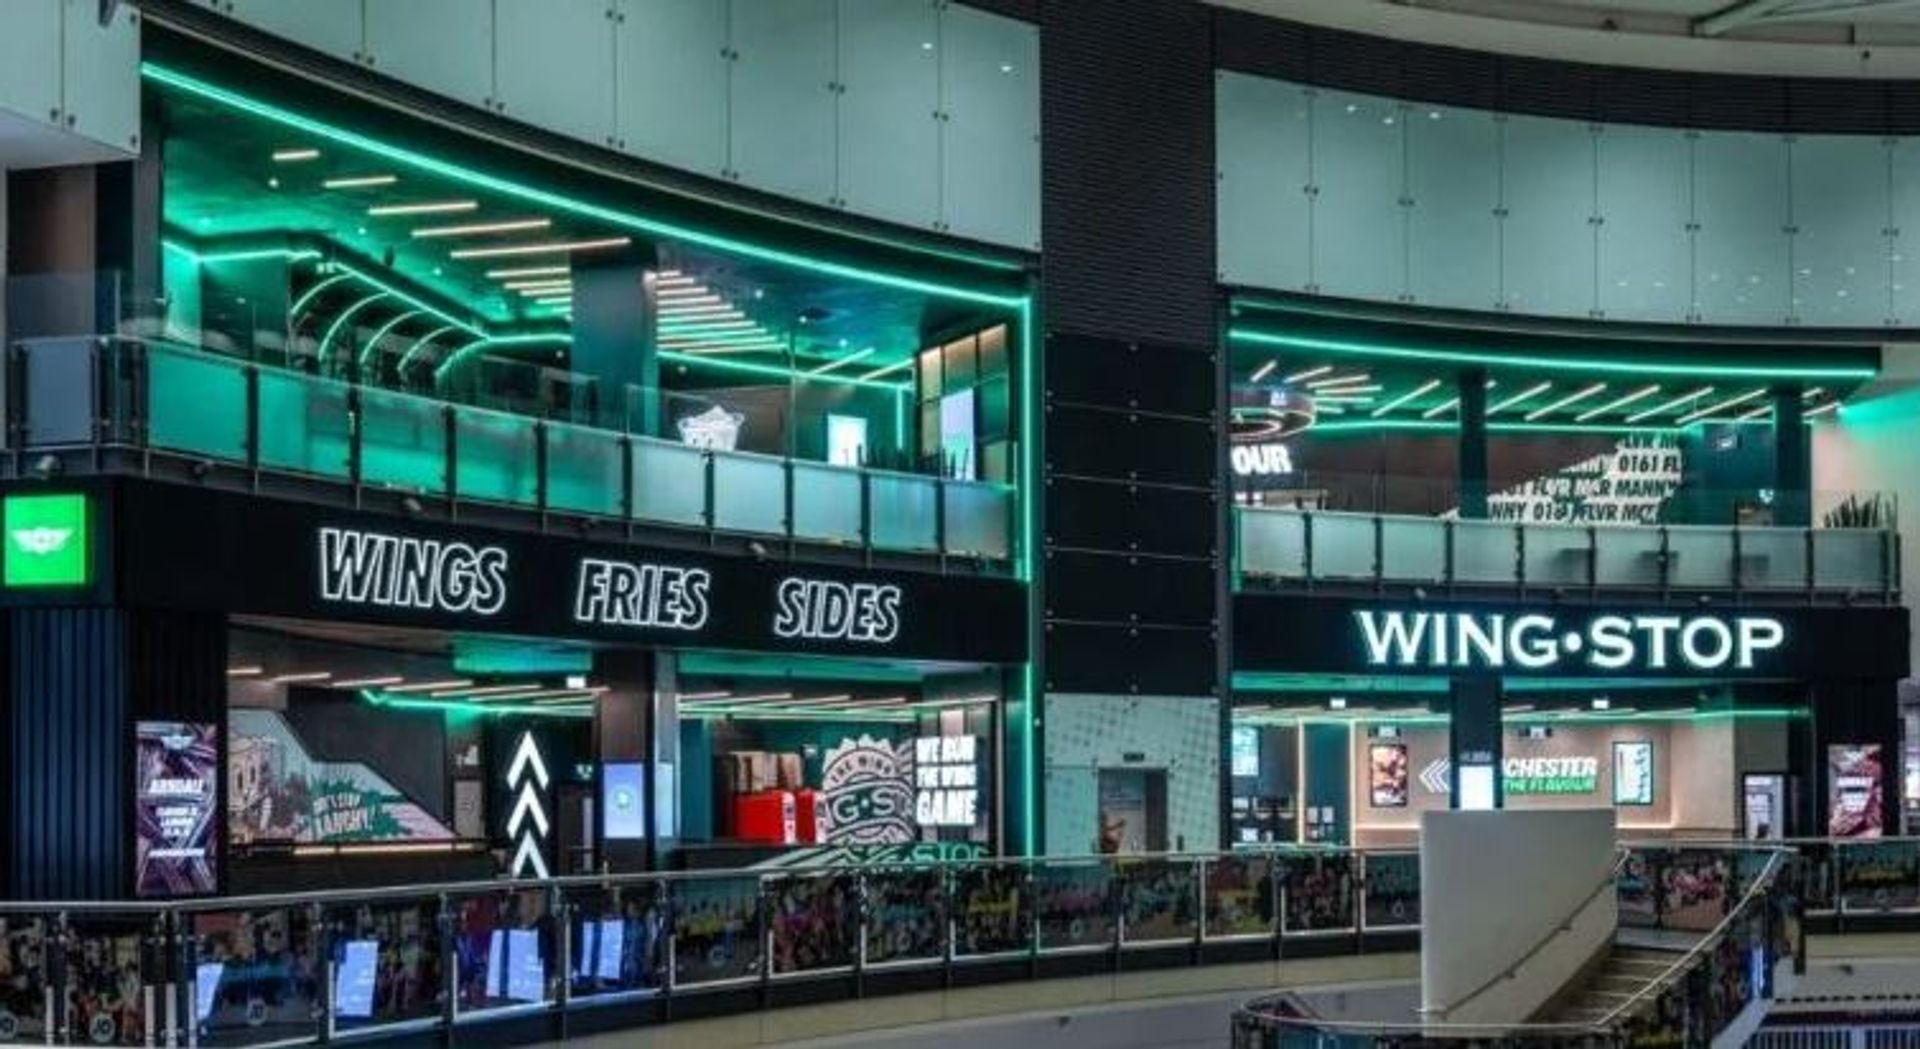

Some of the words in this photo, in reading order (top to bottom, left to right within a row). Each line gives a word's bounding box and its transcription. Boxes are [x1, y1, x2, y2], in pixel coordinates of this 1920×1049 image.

[1231, 444, 1292, 475] OUR
[1619, 454, 1658, 473] 0161
[319, 528, 507, 614] WINGS
[576, 557, 710, 630] FRIES
[773, 578, 900, 642] SIDES
[1503, 756, 1598, 778] CHESTER
[917, 790, 978, 825] GAME
